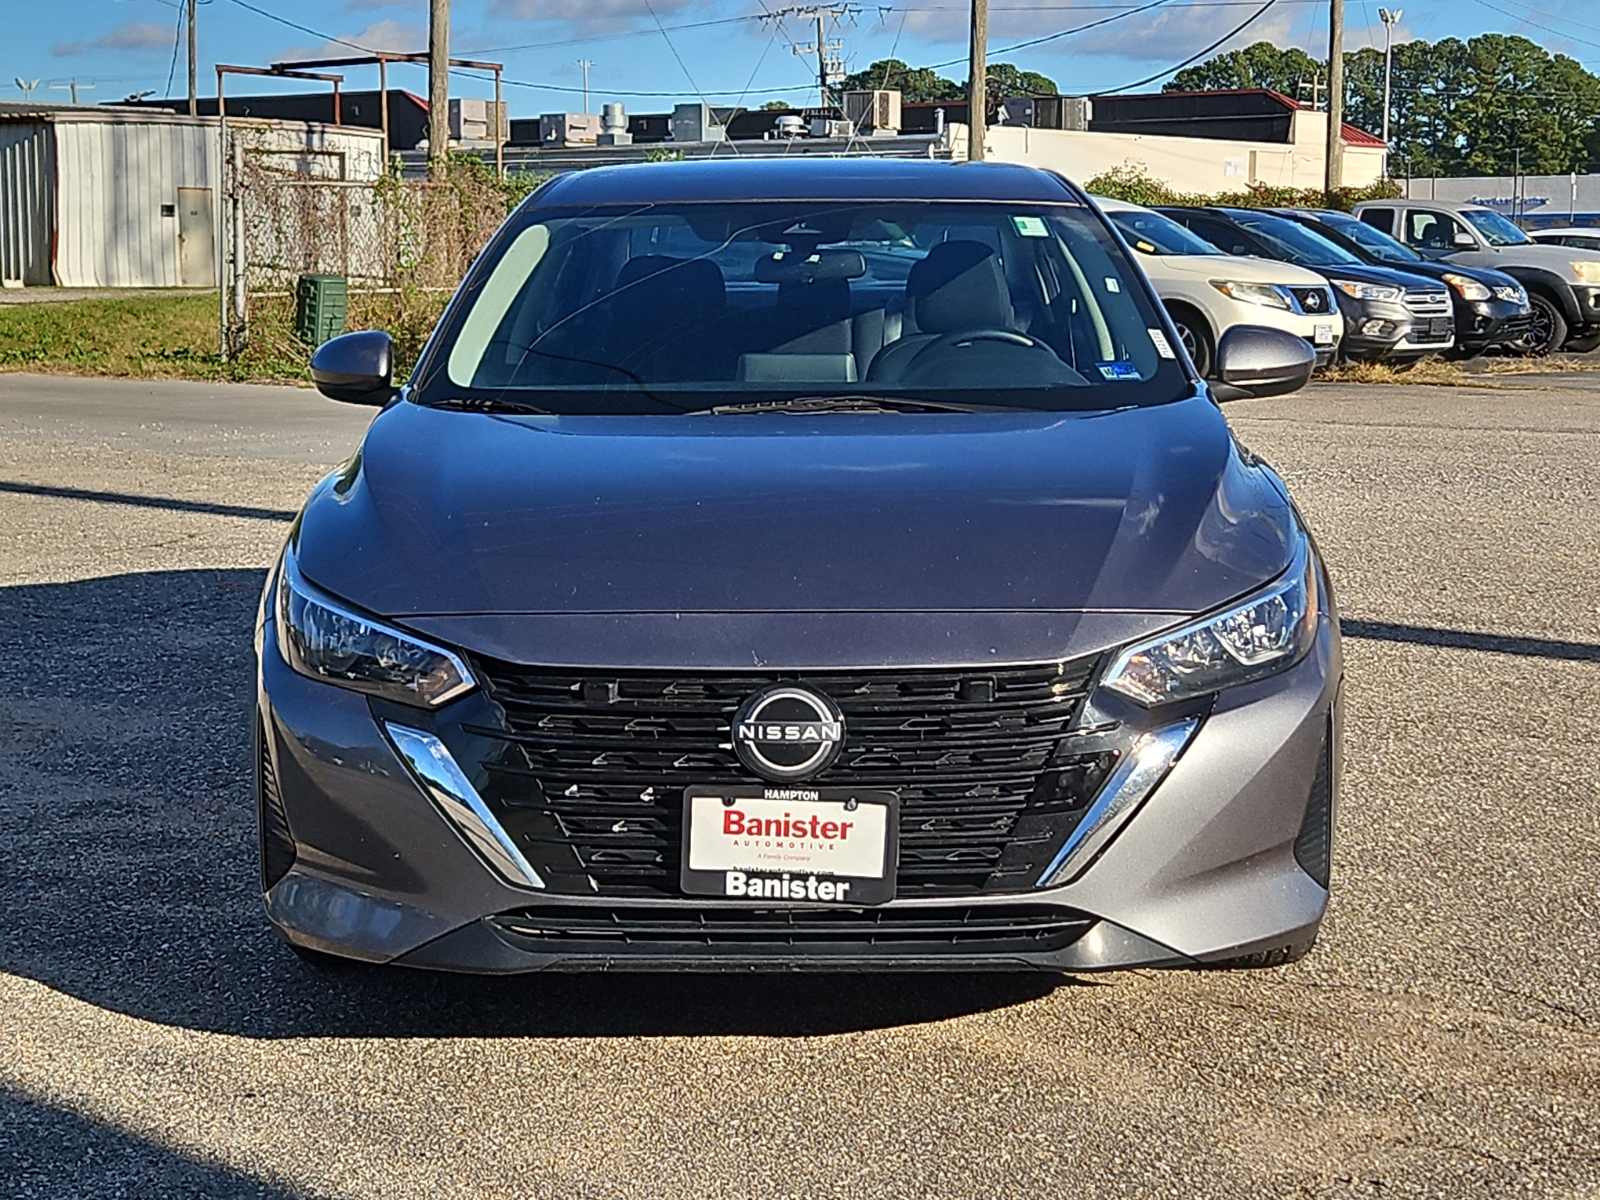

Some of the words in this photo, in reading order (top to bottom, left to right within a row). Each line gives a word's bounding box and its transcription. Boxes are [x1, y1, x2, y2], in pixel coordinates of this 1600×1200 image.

[739, 725, 837, 740] NISSAN
[763, 789, 819, 801] HAMPTON
[723, 810, 854, 840] Banister
[733, 840, 835, 850] AUTOMOTIVE
[763, 853, 782, 861] Family
[783, 854, 811, 862] Company
[726, 871, 850, 901] Banister
